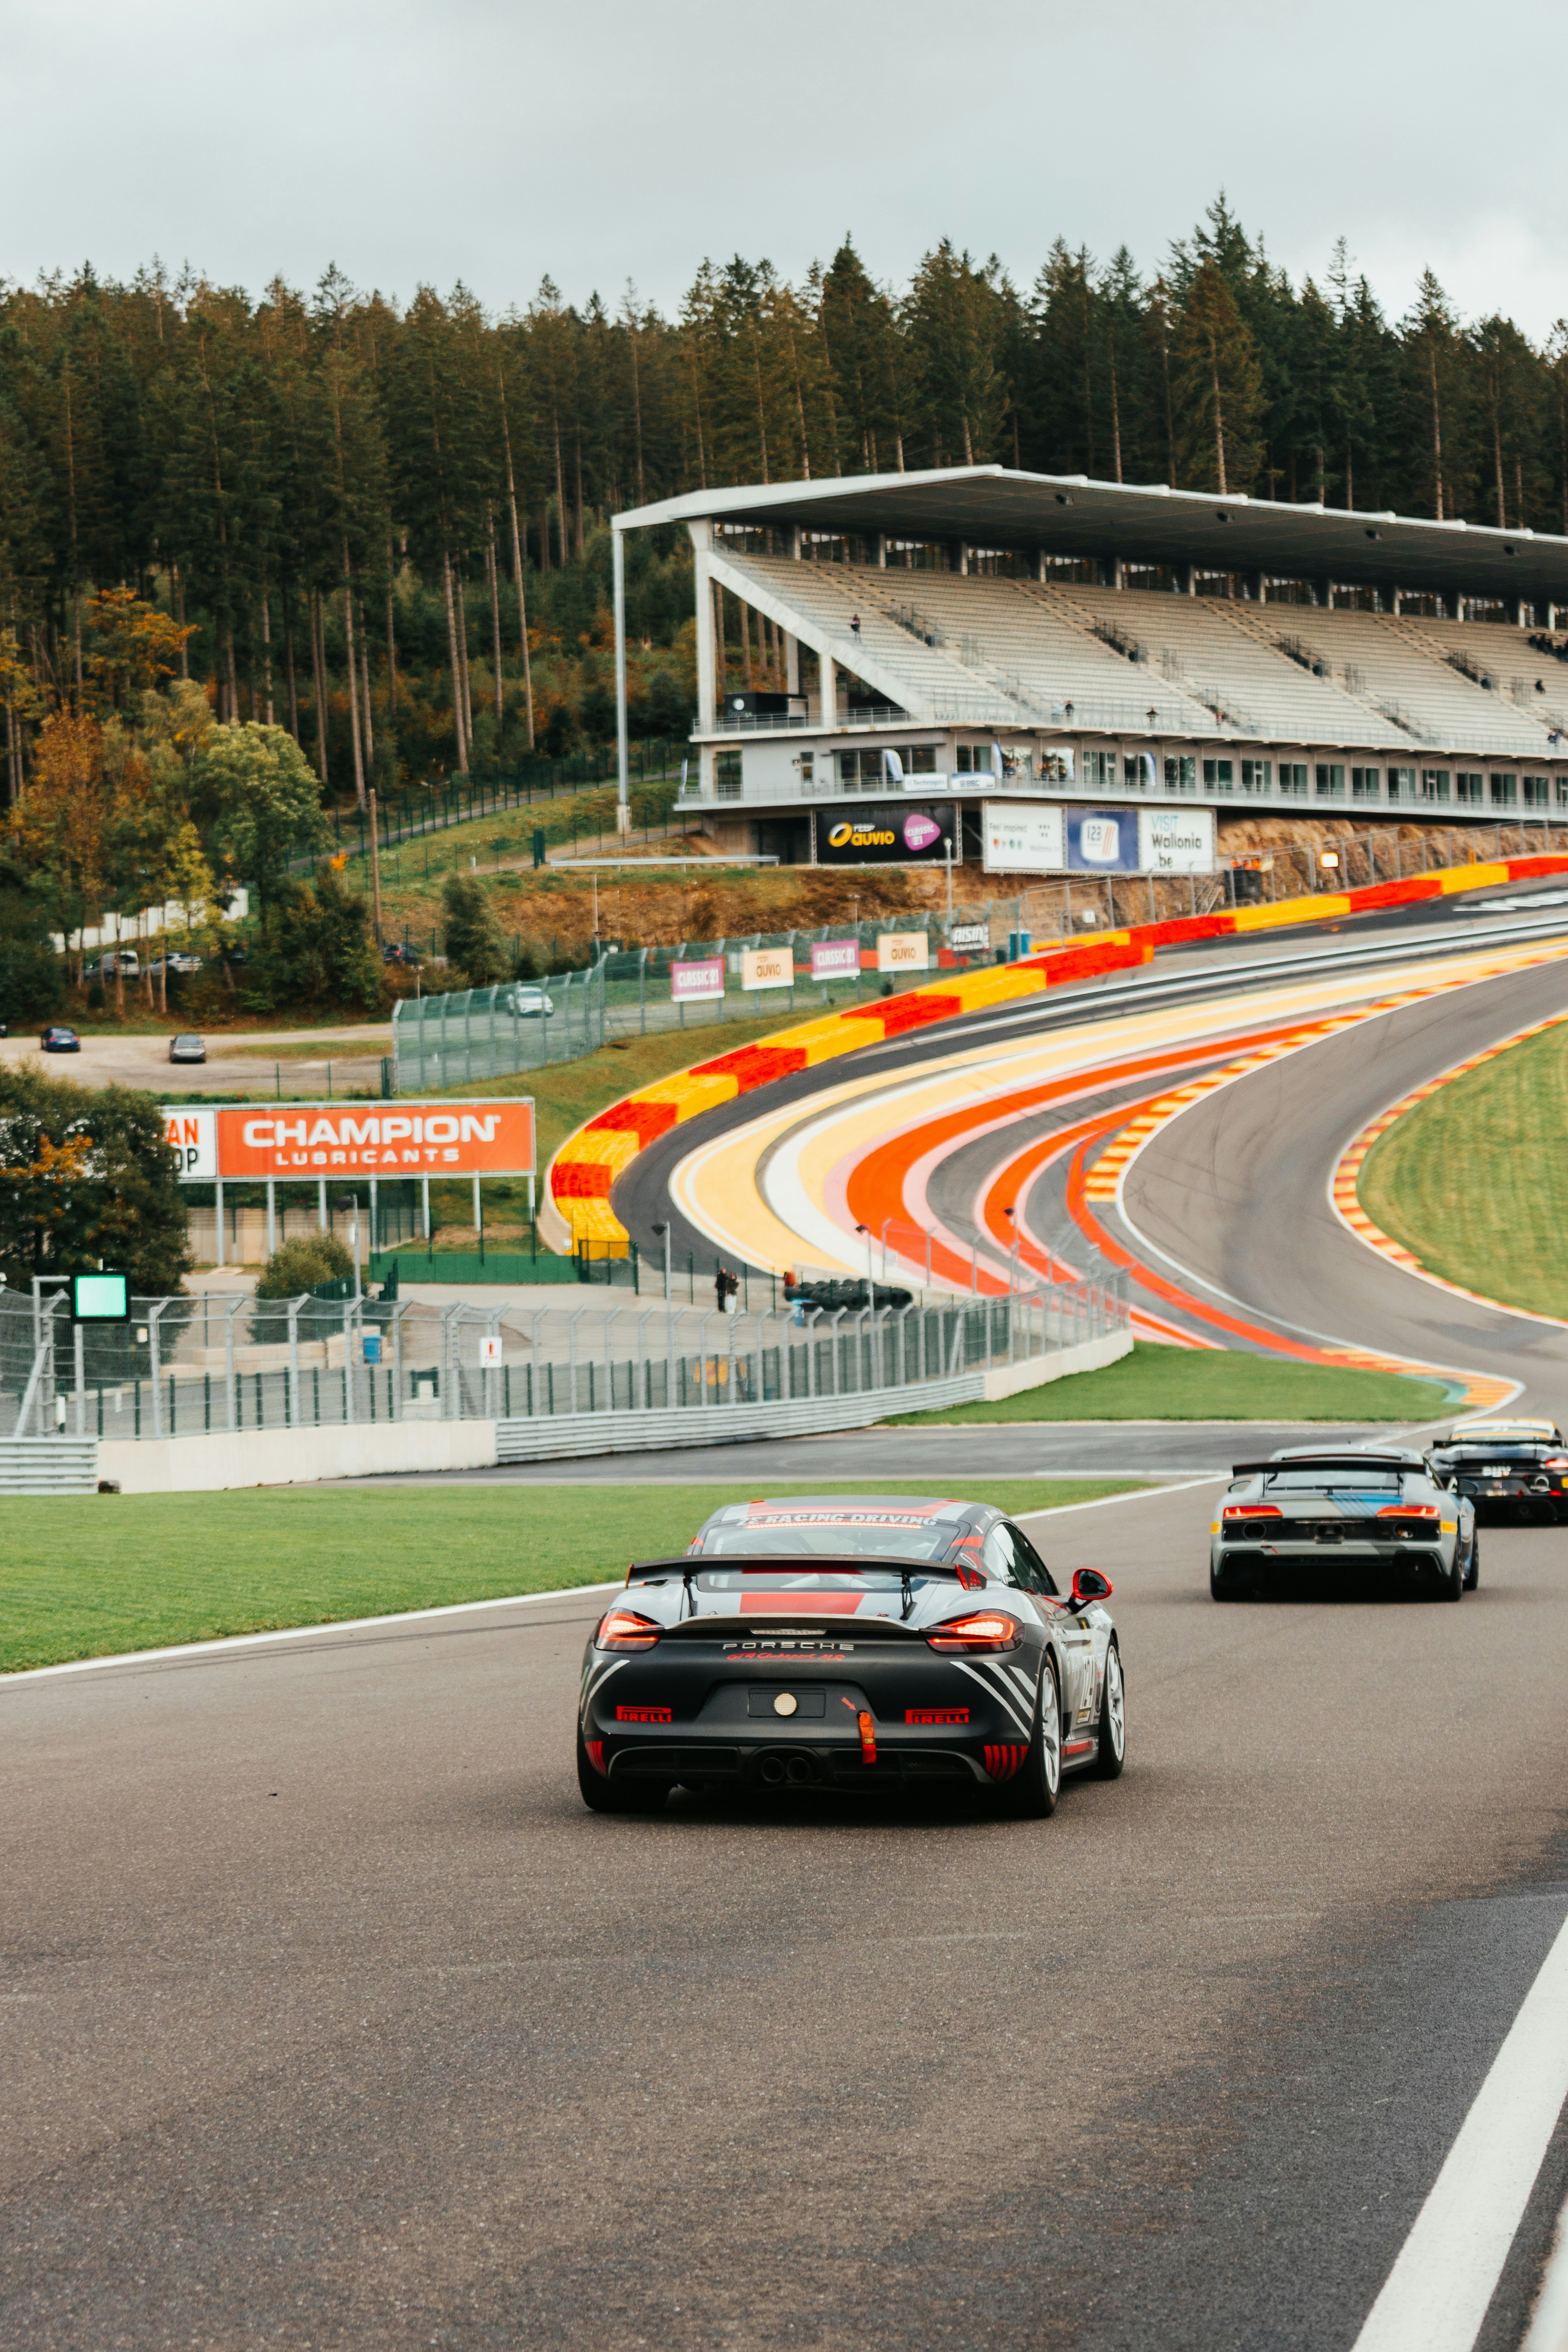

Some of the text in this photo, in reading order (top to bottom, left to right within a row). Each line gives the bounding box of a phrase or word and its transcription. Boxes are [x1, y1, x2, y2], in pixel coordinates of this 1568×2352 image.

[907, 824, 935, 837] CLASSIC
[989, 822, 1028, 833] Feel inspired
[1152, 816, 1179, 832] VISIT
[850, 831, 895, 846] auvio
[912, 835, 923, 846] 21
[1087, 825, 1102, 842] 123
[1152, 832, 1202, 849] Wallonia
[817, 947, 855, 966] CLASSIC 21
[891, 947, 917, 960] auvio
[677, 968, 719, 987] CLASSIC 21
[757, 964, 781, 977] auvio
[244, 1115, 495, 1147] CHAMPION
[276, 1148, 459, 1165] LUBRICANTS
[765, 1513, 846, 1524] RACING
[850, 1514, 938, 1526] DRIVING
[723, 1642, 854, 1651] PORSCHE
[616, 1706, 672, 1722] PIRELLI
[905, 1708, 969, 1724] PIRELLI
